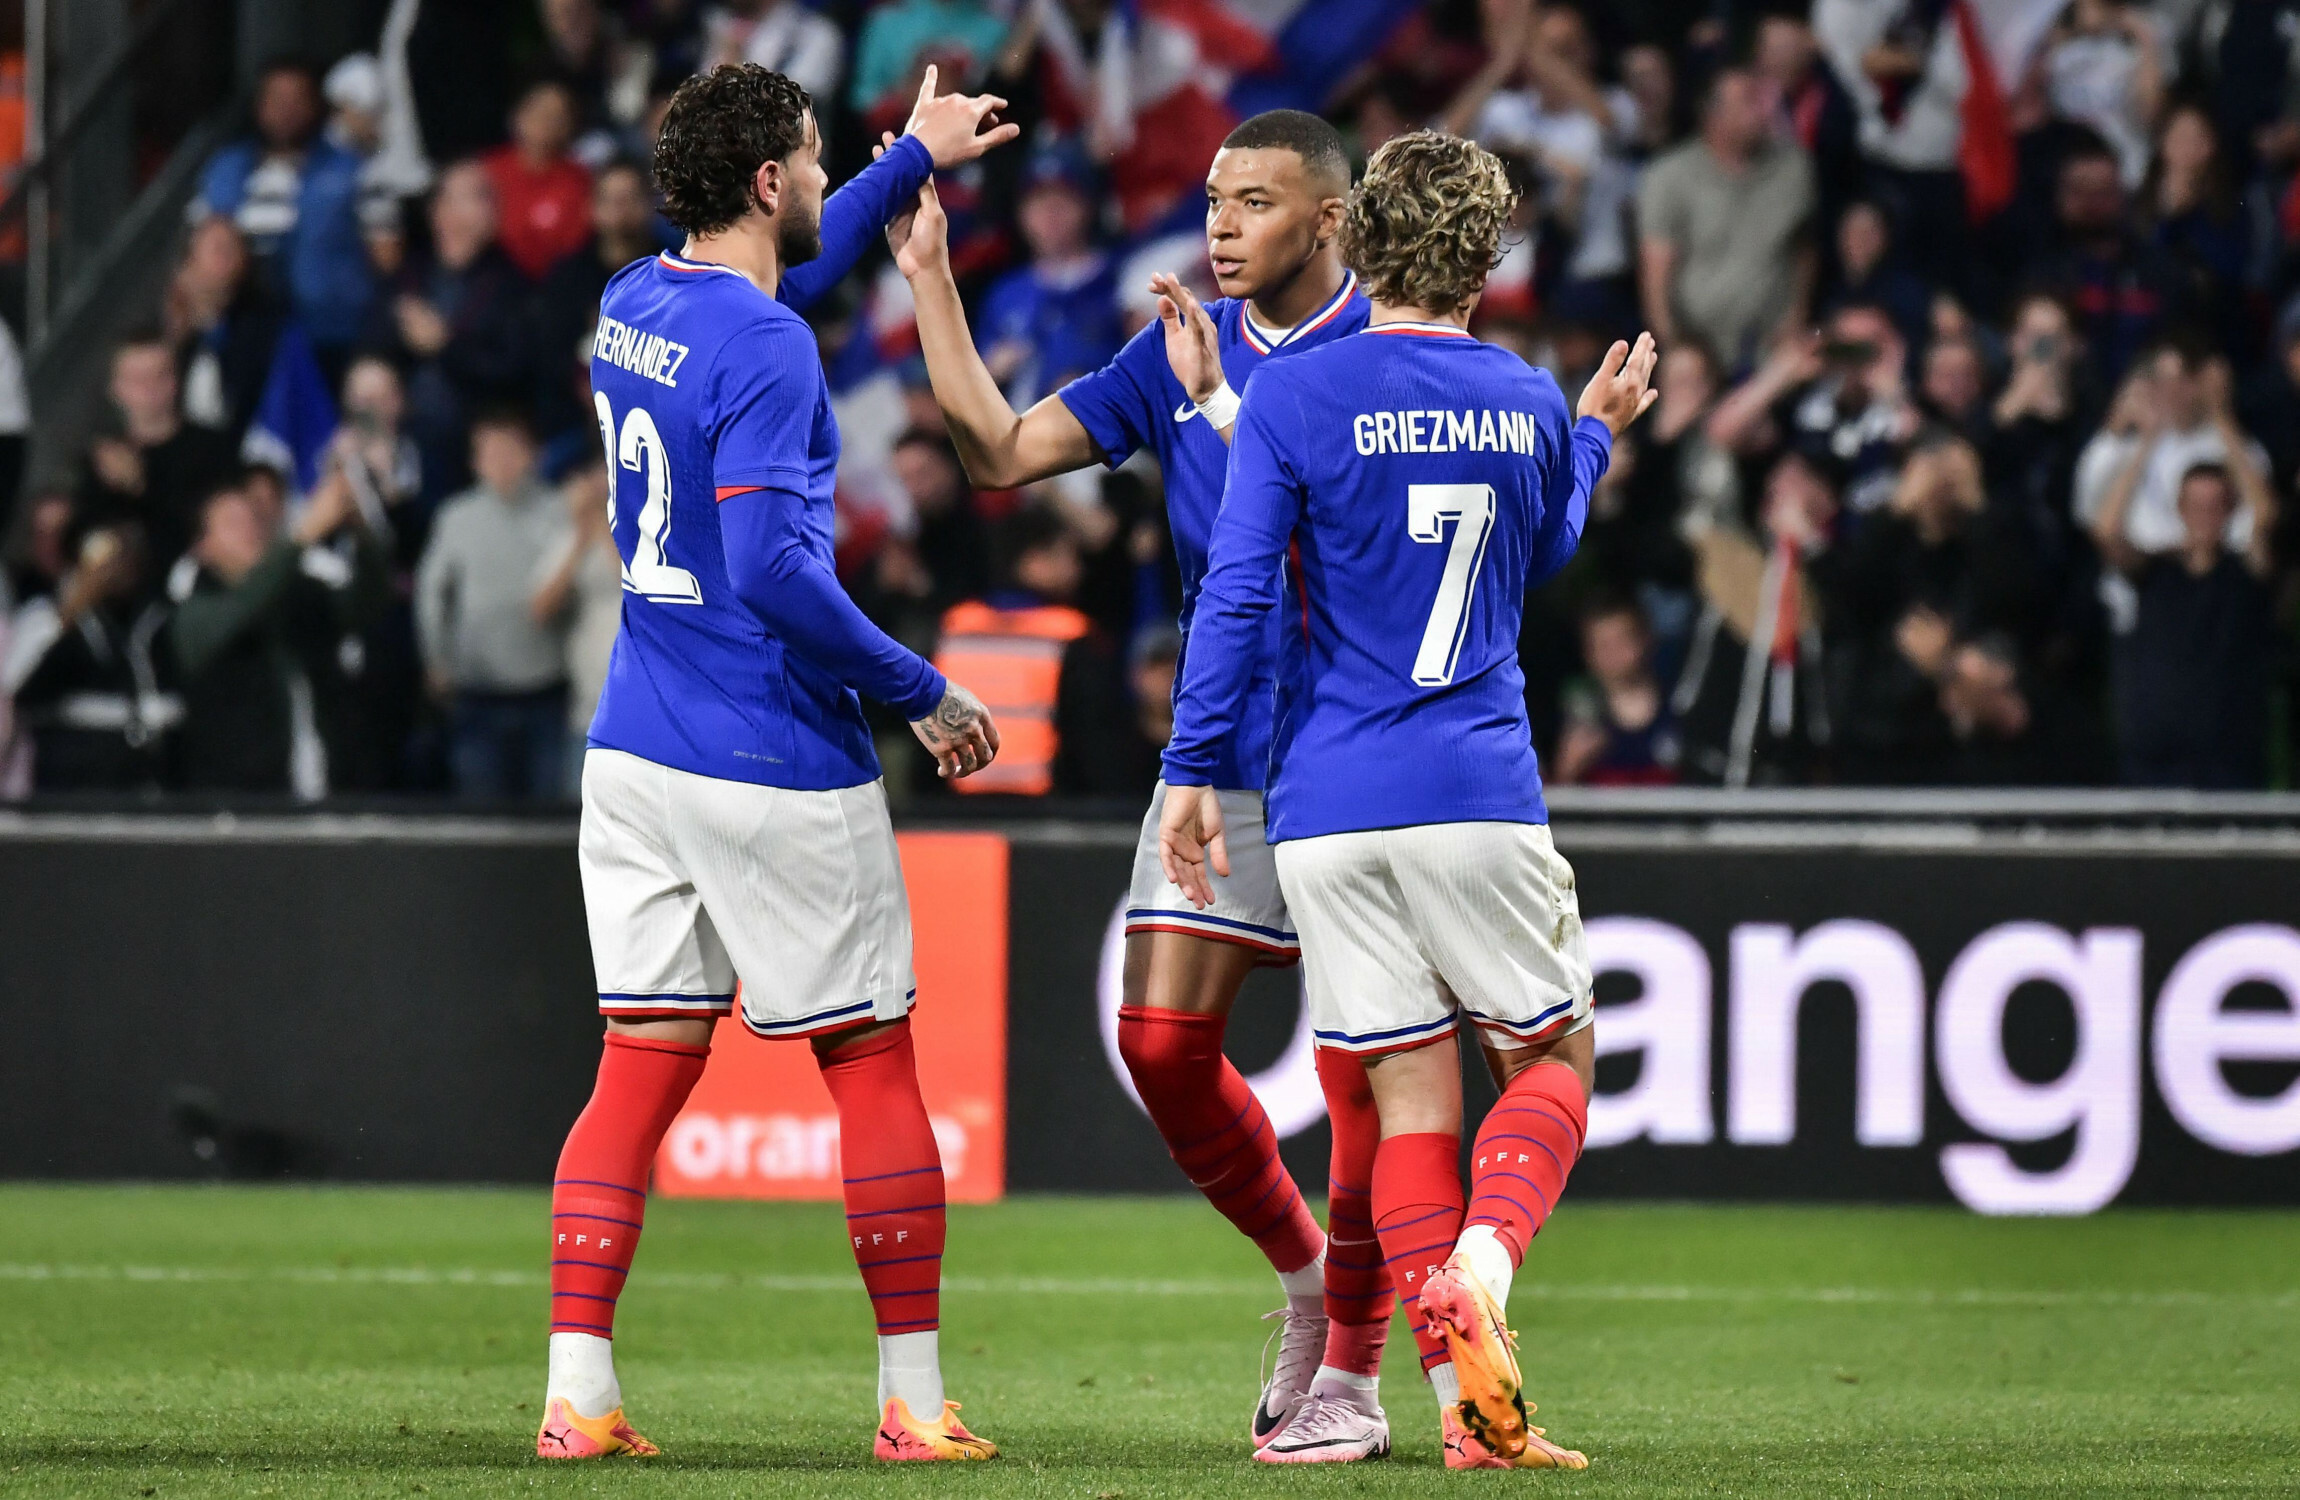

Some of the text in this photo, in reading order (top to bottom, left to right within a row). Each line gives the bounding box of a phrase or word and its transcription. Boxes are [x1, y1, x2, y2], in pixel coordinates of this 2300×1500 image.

[593, 315, 690, 388] HERNANDEZ
[1353, 409, 1536, 457] GRIEZMANN
[1408, 483, 1496, 687] 7
